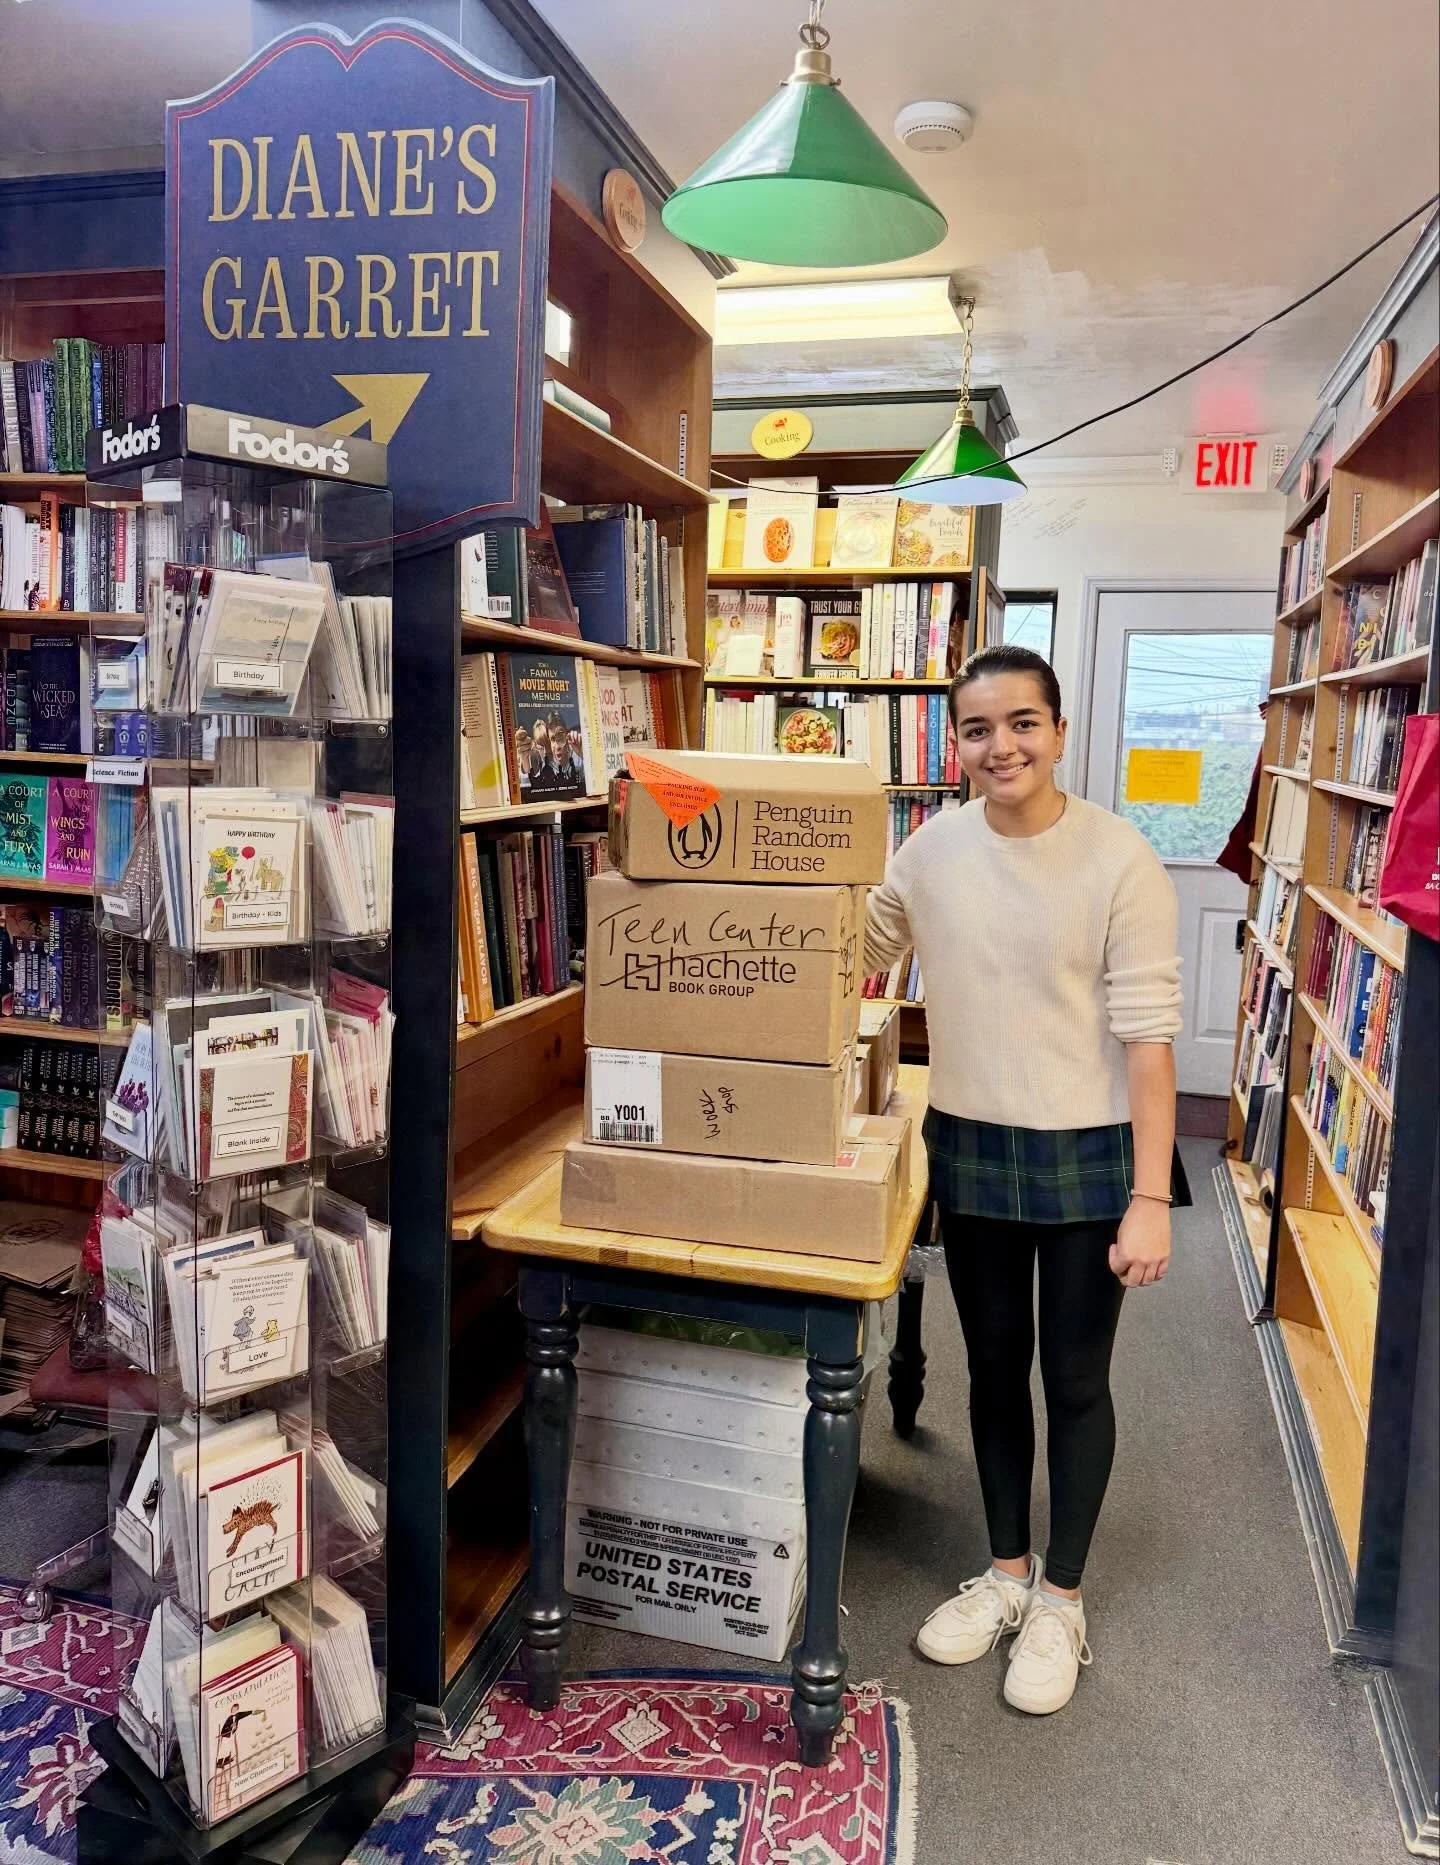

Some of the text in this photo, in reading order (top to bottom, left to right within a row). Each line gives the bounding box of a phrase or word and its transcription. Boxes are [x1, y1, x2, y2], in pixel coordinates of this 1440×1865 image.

[207, 123, 497, 223] DIANE'S
[202, 250, 500, 341] GARRET
[3, 383, 21, 446] HELL BENT
[102, 414, 161, 464] Fodor's
[228, 417, 350, 476] Fodor's
[764, 430, 801, 447] Cooking
[1195, 441, 1258, 488] EXIT
[810, 600, 853, 614] TRUST YOUR
[896, 610, 904, 656] PLENTY
[233, 670, 265, 681] Birthday
[530, 669, 559, 678] FAMILY
[519, 678, 570, 692] MOVIE NIGHT
[33, 689, 76, 705] WICKED
[494, 695, 500, 706] OF
[531, 692, 561, 701] MENUS
[40, 704, 66, 719] SEA
[117, 769, 139, 777] Fiction
[8, 786, 44, 798] COURT
[63, 788, 95, 800] COURT
[14, 801, 25, 809] OF
[82, 805, 91, 813] OF
[5, 814, 33, 825] MIST
[51, 815, 86, 830] WINGS
[753, 800, 853, 829] Penguin
[11, 830, 27, 838] AND
[60, 833, 75, 842] AND
[227, 829, 276, 839] HAPPY BIRTHDAY
[752, 825, 852, 850] Random
[4, 841, 34, 854] FURY
[66, 847, 91, 861] RUIN
[0, 859, 15, 868] ARAH
[48, 862, 92, 874] SARAH MAAS
[750, 850, 826, 873] House
[232, 909, 282, 920] Birthday Kids
[470, 867, 478, 888] BIG
[478, 938, 488, 985] FLAVOR
[597, 903, 825, 956] Teen Center
[669, 946, 797, 984] hachette
[669, 981, 755, 998] BOOK GROUP
[614, 1104, 645, 1121] Y001
[698, 1088, 721, 1139] WORK
[34, 1116, 42, 1134] WING
[40, 1113, 48, 1138] FOURTH
[56, 1115, 64, 1140] FOURTH
[72, 1118, 80, 1143] FOURTH
[88, 1121, 96, 1146] FOURTH
[227, 1135, 271, 1148] Blank Inside
[248, 1350, 269, 1362] Love
[587, 1508, 632, 1526] WARNING
[640, 1519, 661, 1533] NOT
[662, 1523, 683, 1536] FOR
[684, 1528, 725, 1545] PRIVATE
[727, 1534, 748, 1548] USE
[235, 1554, 285, 1578] Encouragement
[585, 1541, 753, 1589] UNITED STATES
[576, 1561, 660, 1595] POSTAL
[665, 1581, 762, 1614] SERVICE
[635, 1595, 697, 1614] FOR MAIL ONLY
